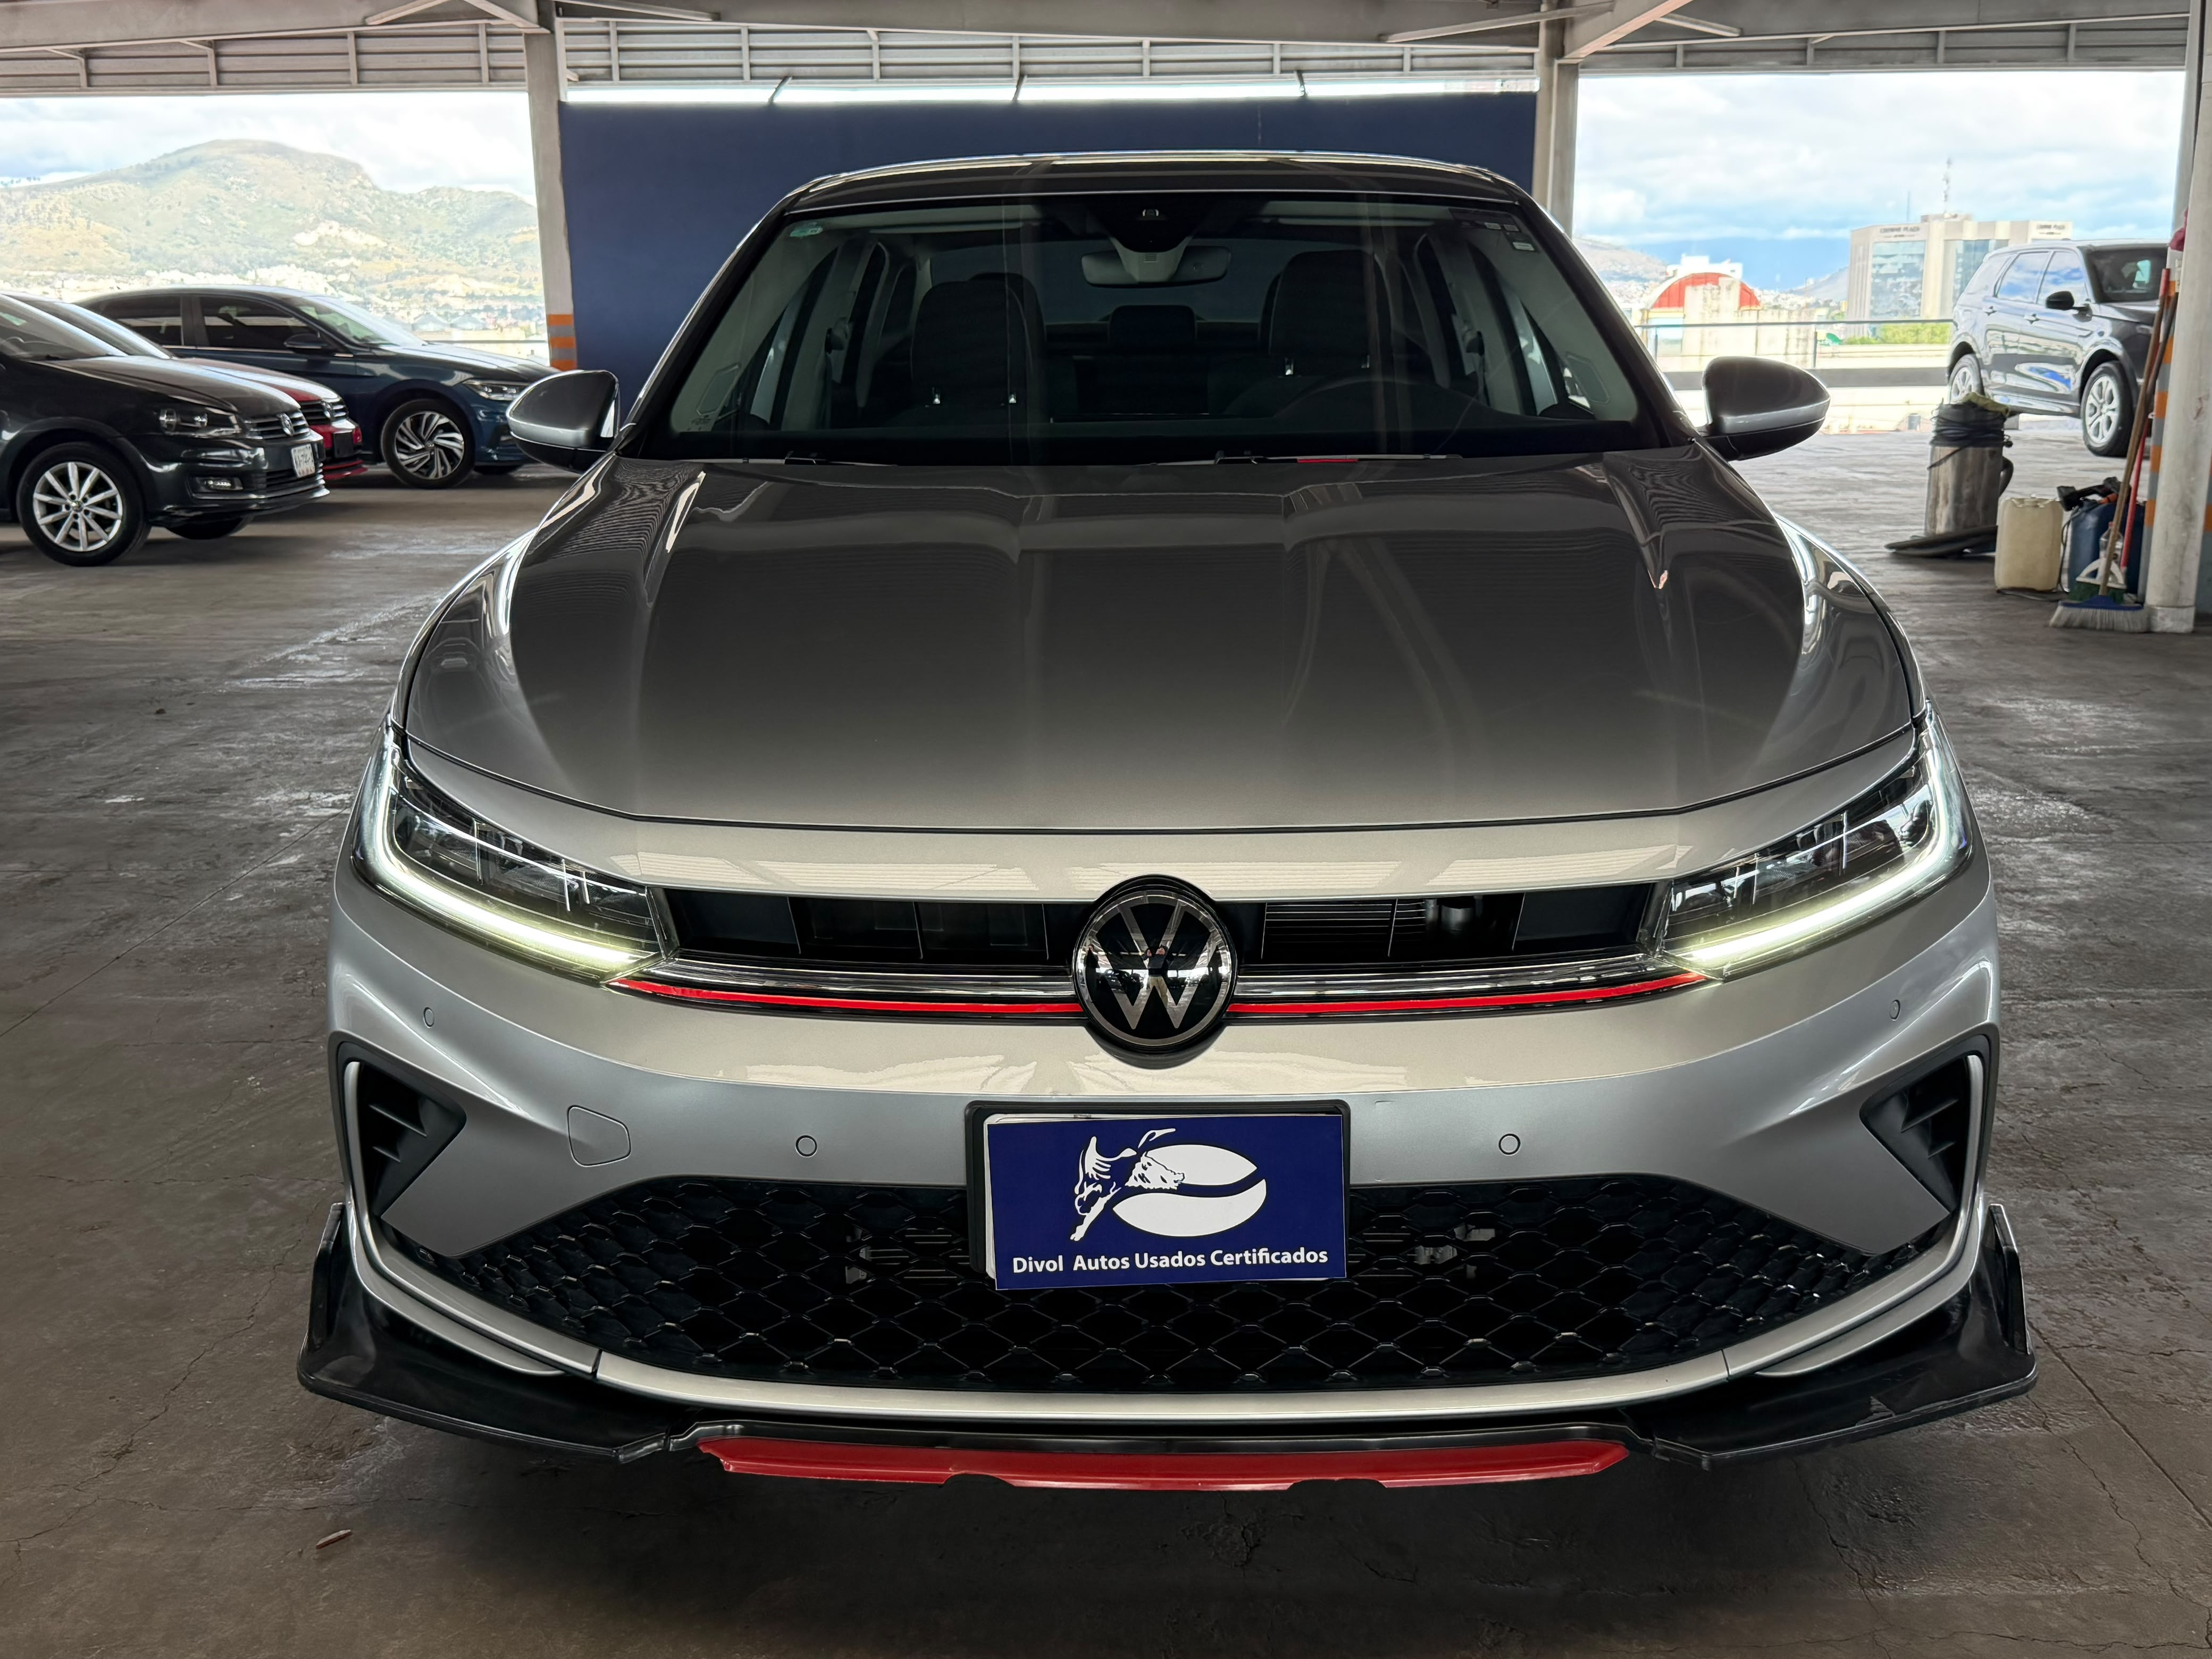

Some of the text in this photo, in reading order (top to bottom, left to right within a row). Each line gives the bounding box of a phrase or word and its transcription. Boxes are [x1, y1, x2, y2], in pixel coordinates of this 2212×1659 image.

[1013, 1247, 1328, 1273] Divol Autos Usados Certificados
